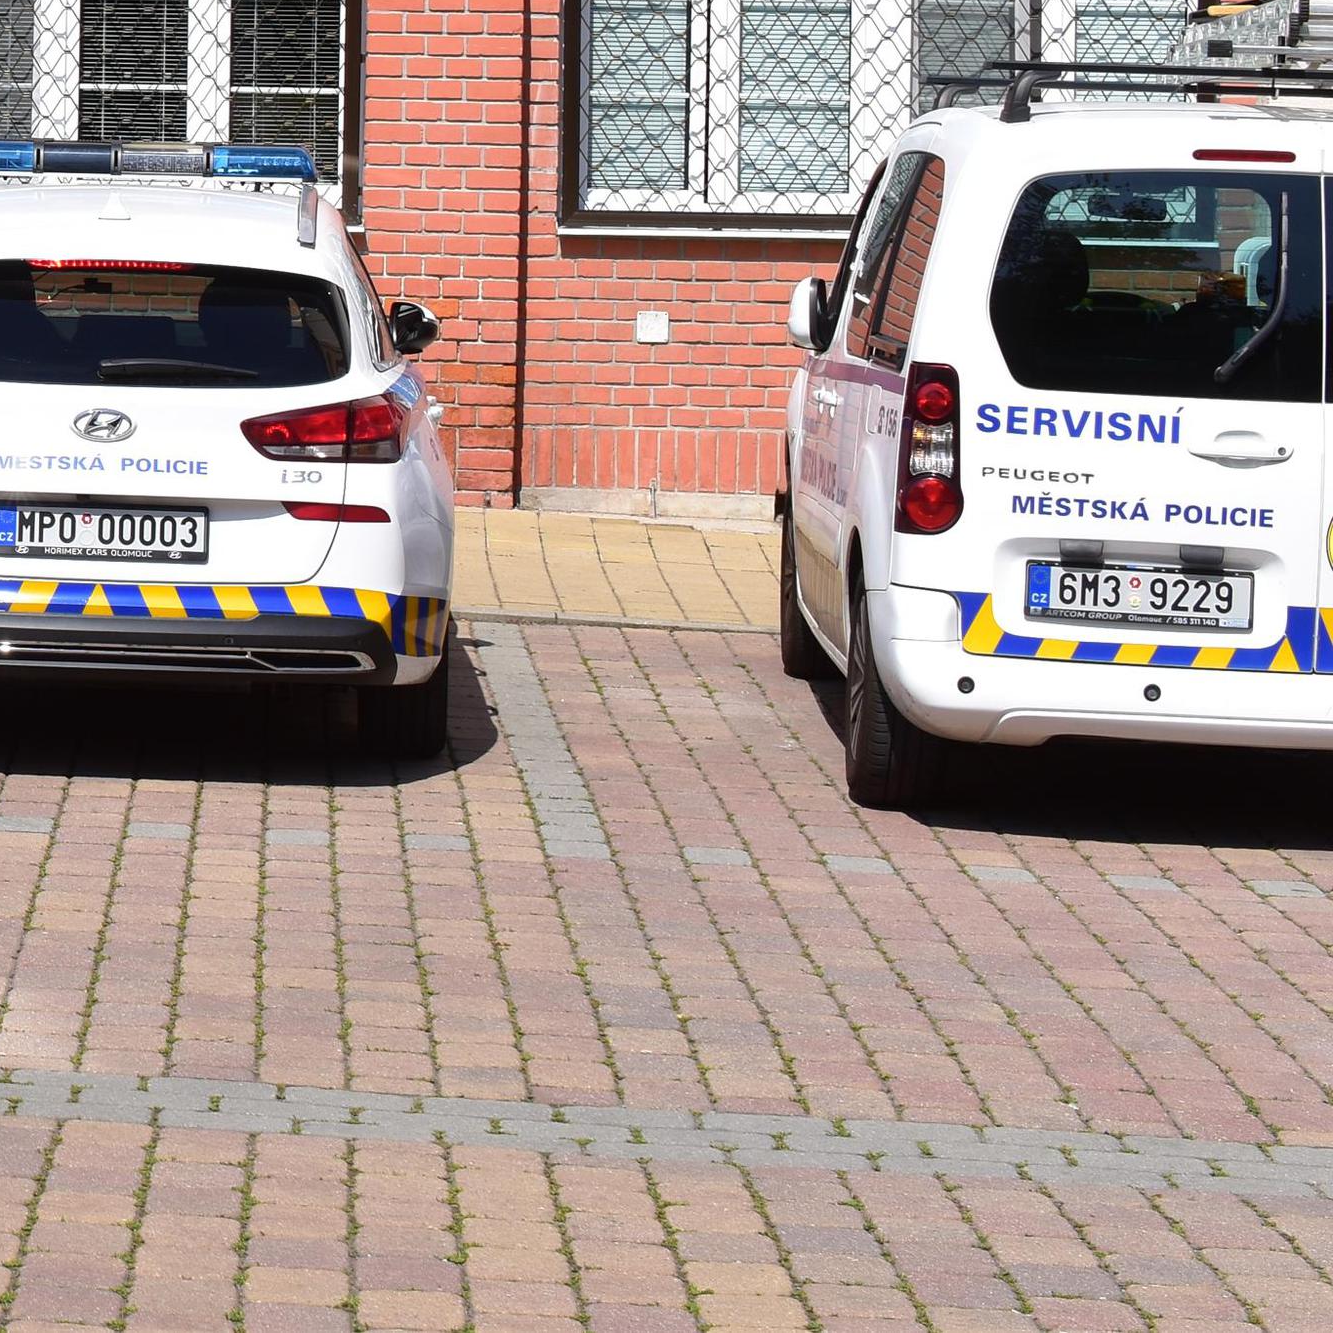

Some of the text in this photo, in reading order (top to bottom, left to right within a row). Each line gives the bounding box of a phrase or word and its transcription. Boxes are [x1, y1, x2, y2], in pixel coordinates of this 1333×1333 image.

[975, 403, 1184, 444] SERVISNÍ
[121, 457, 208, 475] POLICIE
[281, 469, 323, 484] i30
[982, 466, 1095, 485] PEUGEOT
[1011, 492, 1274, 528] MĚSTSKÁ POLICIE
[97, 513, 198, 548] 00003
[44, 547, 153, 558] HORIMEX CARS OLOMOUC
[1031, 592, 1048, 604] CZ
[1058, 572, 1233, 614] 6M3 9229
[1044, 609, 1086, 618] ARTCOM
[1088, 610, 1122, 620] GROUP
[1127, 613, 1163, 624] Olomouc
[1173, 616, 1188, 625] 585
[1189, 617, 1201, 625] 311
[1202, 617, 1217, 626] 140
